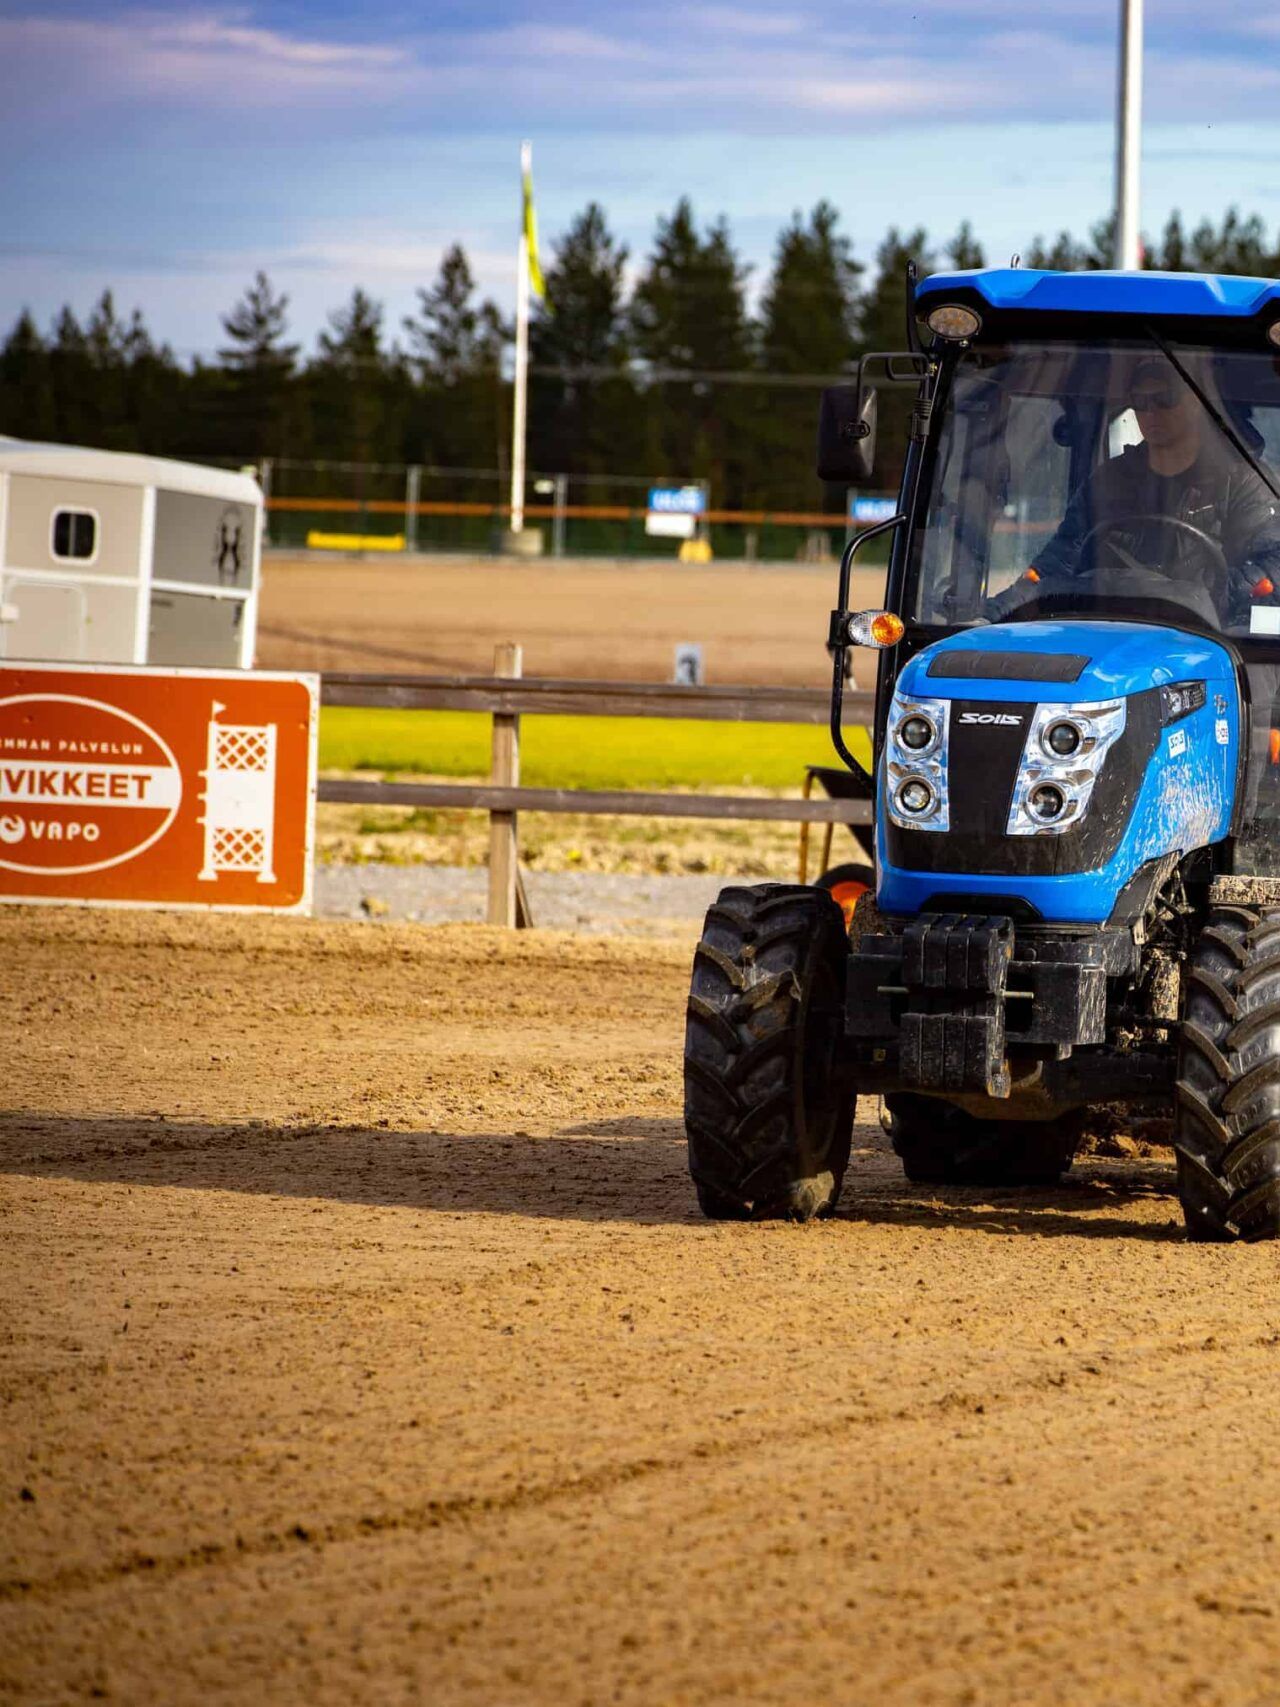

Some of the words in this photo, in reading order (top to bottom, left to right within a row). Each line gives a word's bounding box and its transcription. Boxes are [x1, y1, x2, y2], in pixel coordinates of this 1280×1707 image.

[58, 740, 143, 755] PALVELUN
[0, 768, 152, 800] VIKKEET
[29, 820, 100, 841] VAPO
